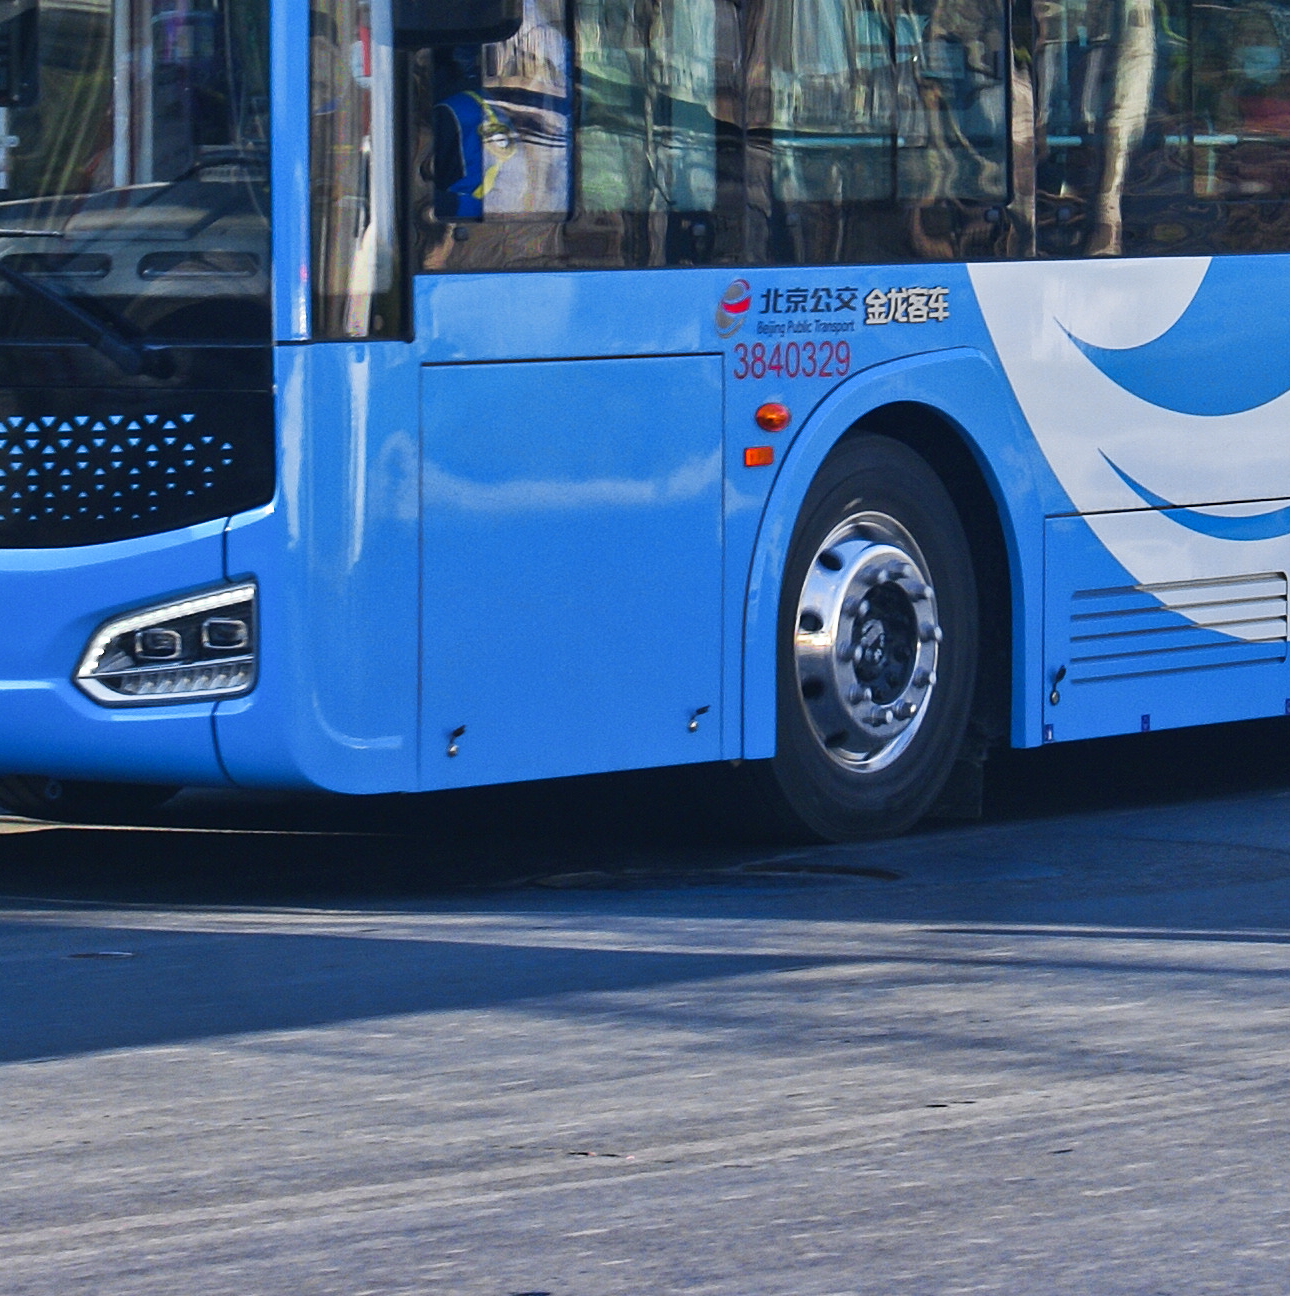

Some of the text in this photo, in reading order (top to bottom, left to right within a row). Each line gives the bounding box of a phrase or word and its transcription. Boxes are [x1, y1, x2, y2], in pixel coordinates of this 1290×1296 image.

[760, 286, 858, 314] 北京公交
[864, 286, 951, 325] 金龙客车
[756, 319, 855, 337] Beijing Public Transport
[733, 340, 851, 379] 3840329
